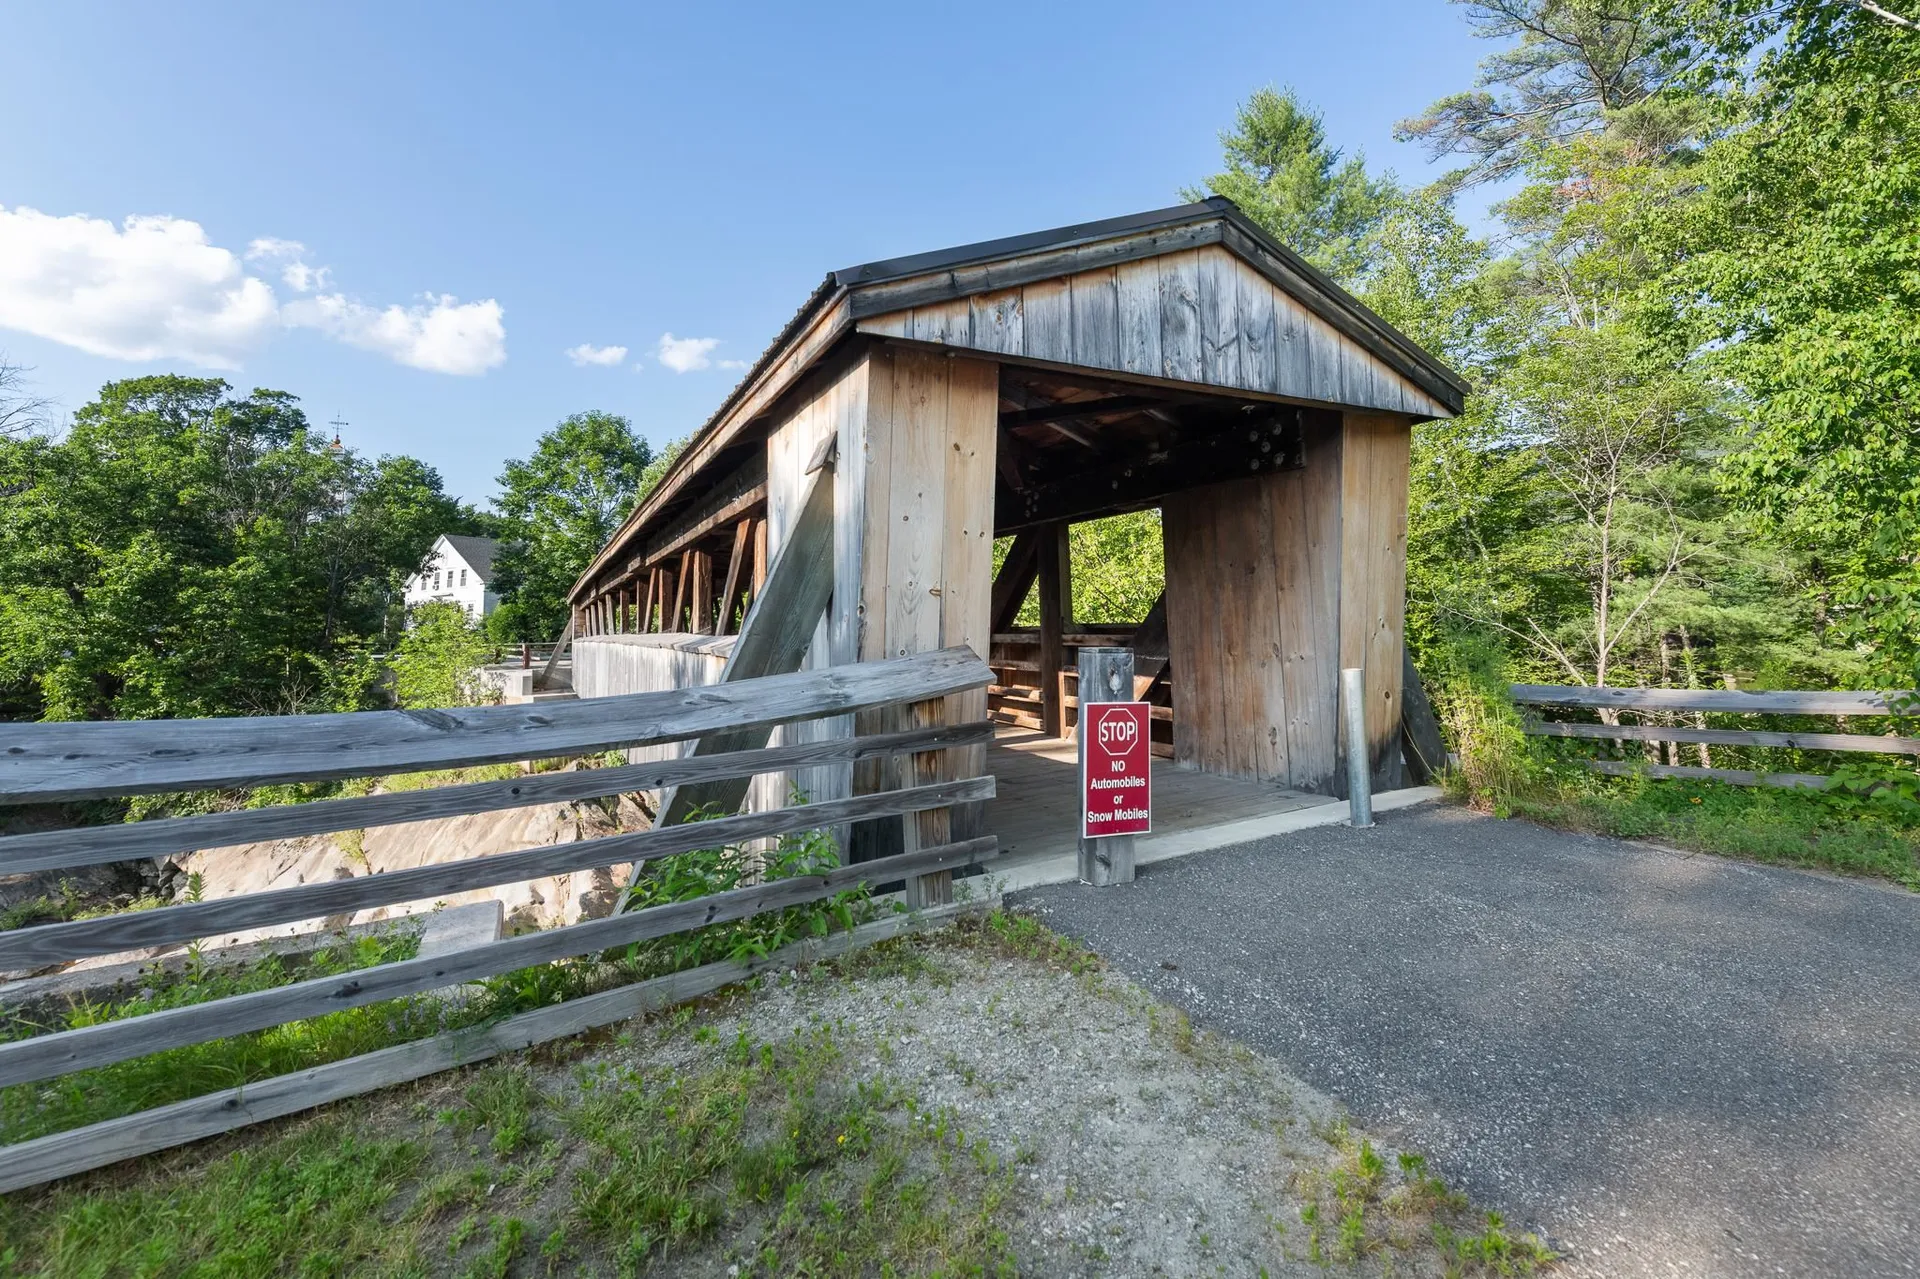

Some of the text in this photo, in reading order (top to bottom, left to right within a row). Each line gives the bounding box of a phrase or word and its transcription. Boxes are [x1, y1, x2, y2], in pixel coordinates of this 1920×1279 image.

[1101, 721, 1136, 742] STOP
[1111, 760, 1125, 772] NO
[1090, 776, 1145, 790] Automobiles
[1113, 795, 1123, 804] or
[1087, 808, 1148, 823] Snow Mobiles
